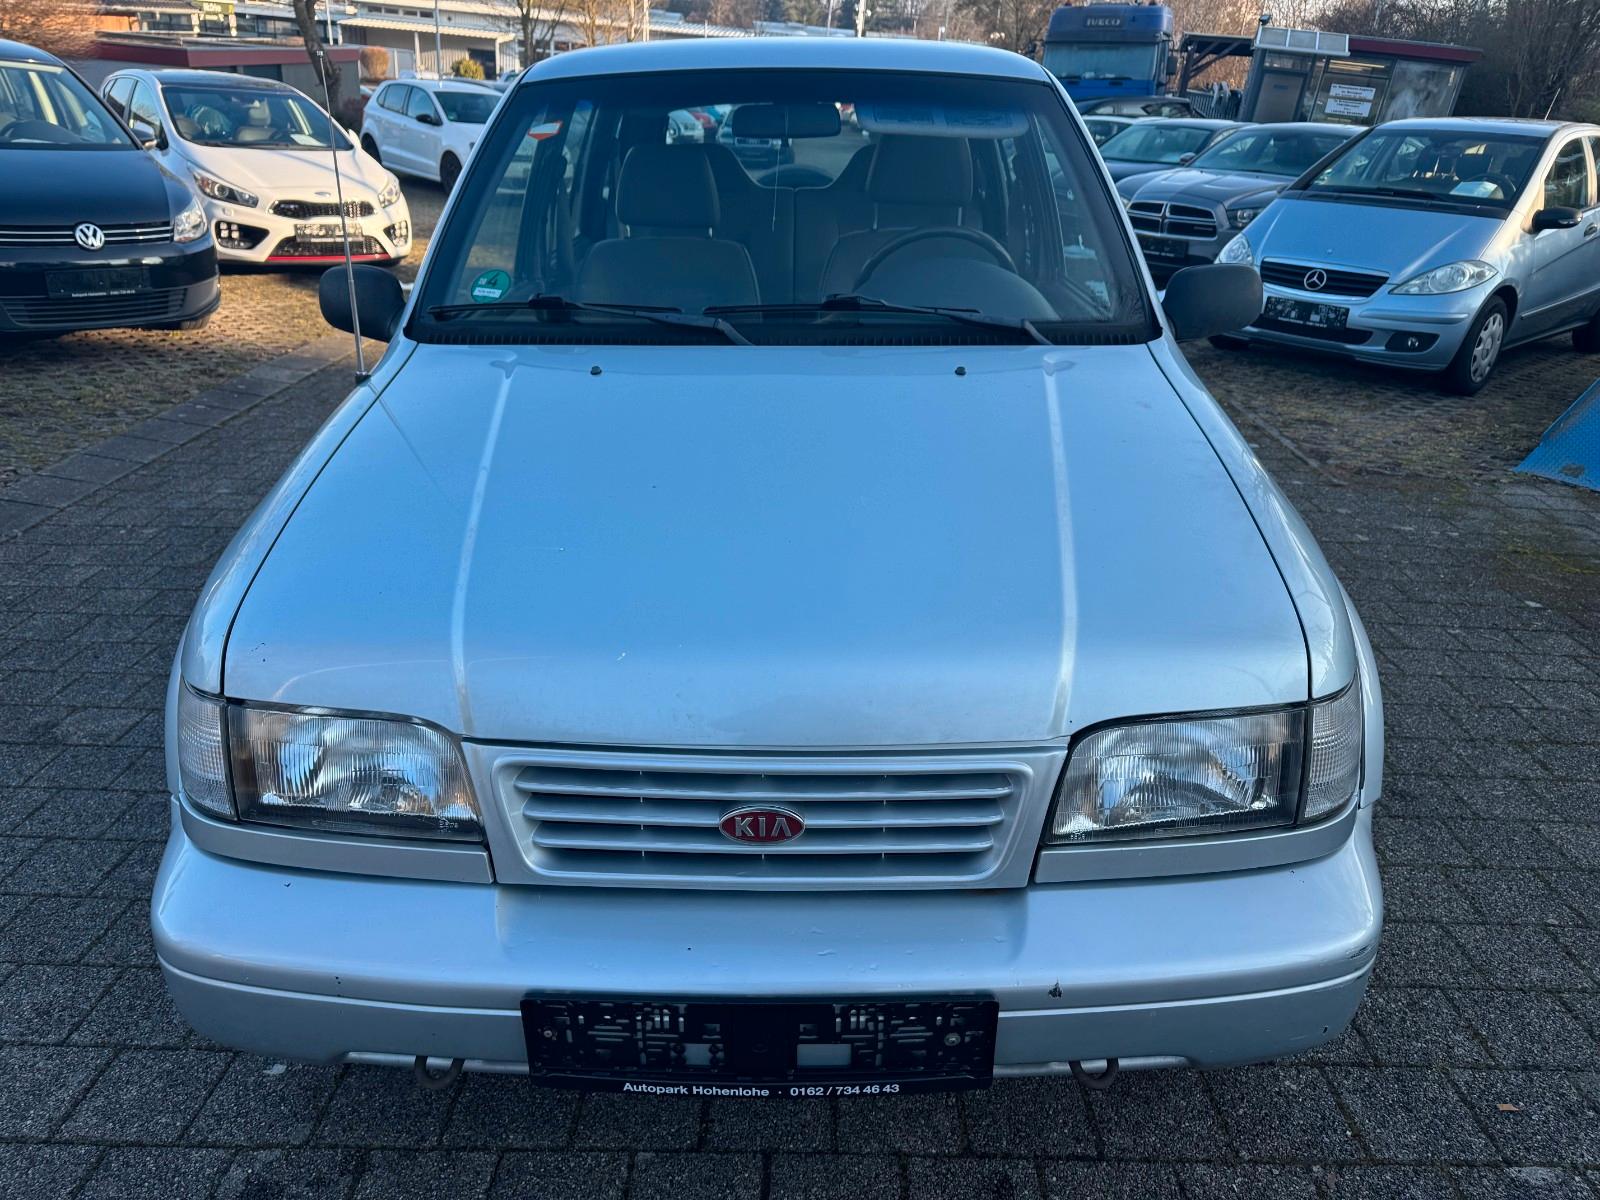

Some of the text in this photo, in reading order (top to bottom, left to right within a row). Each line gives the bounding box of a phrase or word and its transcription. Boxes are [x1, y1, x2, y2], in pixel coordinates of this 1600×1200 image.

[1086, 17, 1120, 26] IVECO
[488, 271, 500, 287] 4
[734, 816, 792, 837] KIA
[623, 1082, 689, 1095] Autopark
[692, 1085, 770, 1097] Hohenlohe
[790, 1086, 825, 1096] 0162
[835, 1085, 861, 1096] 734
[862, 1084, 880, 1095] 46
[882, 1083, 900, 1093] 43
